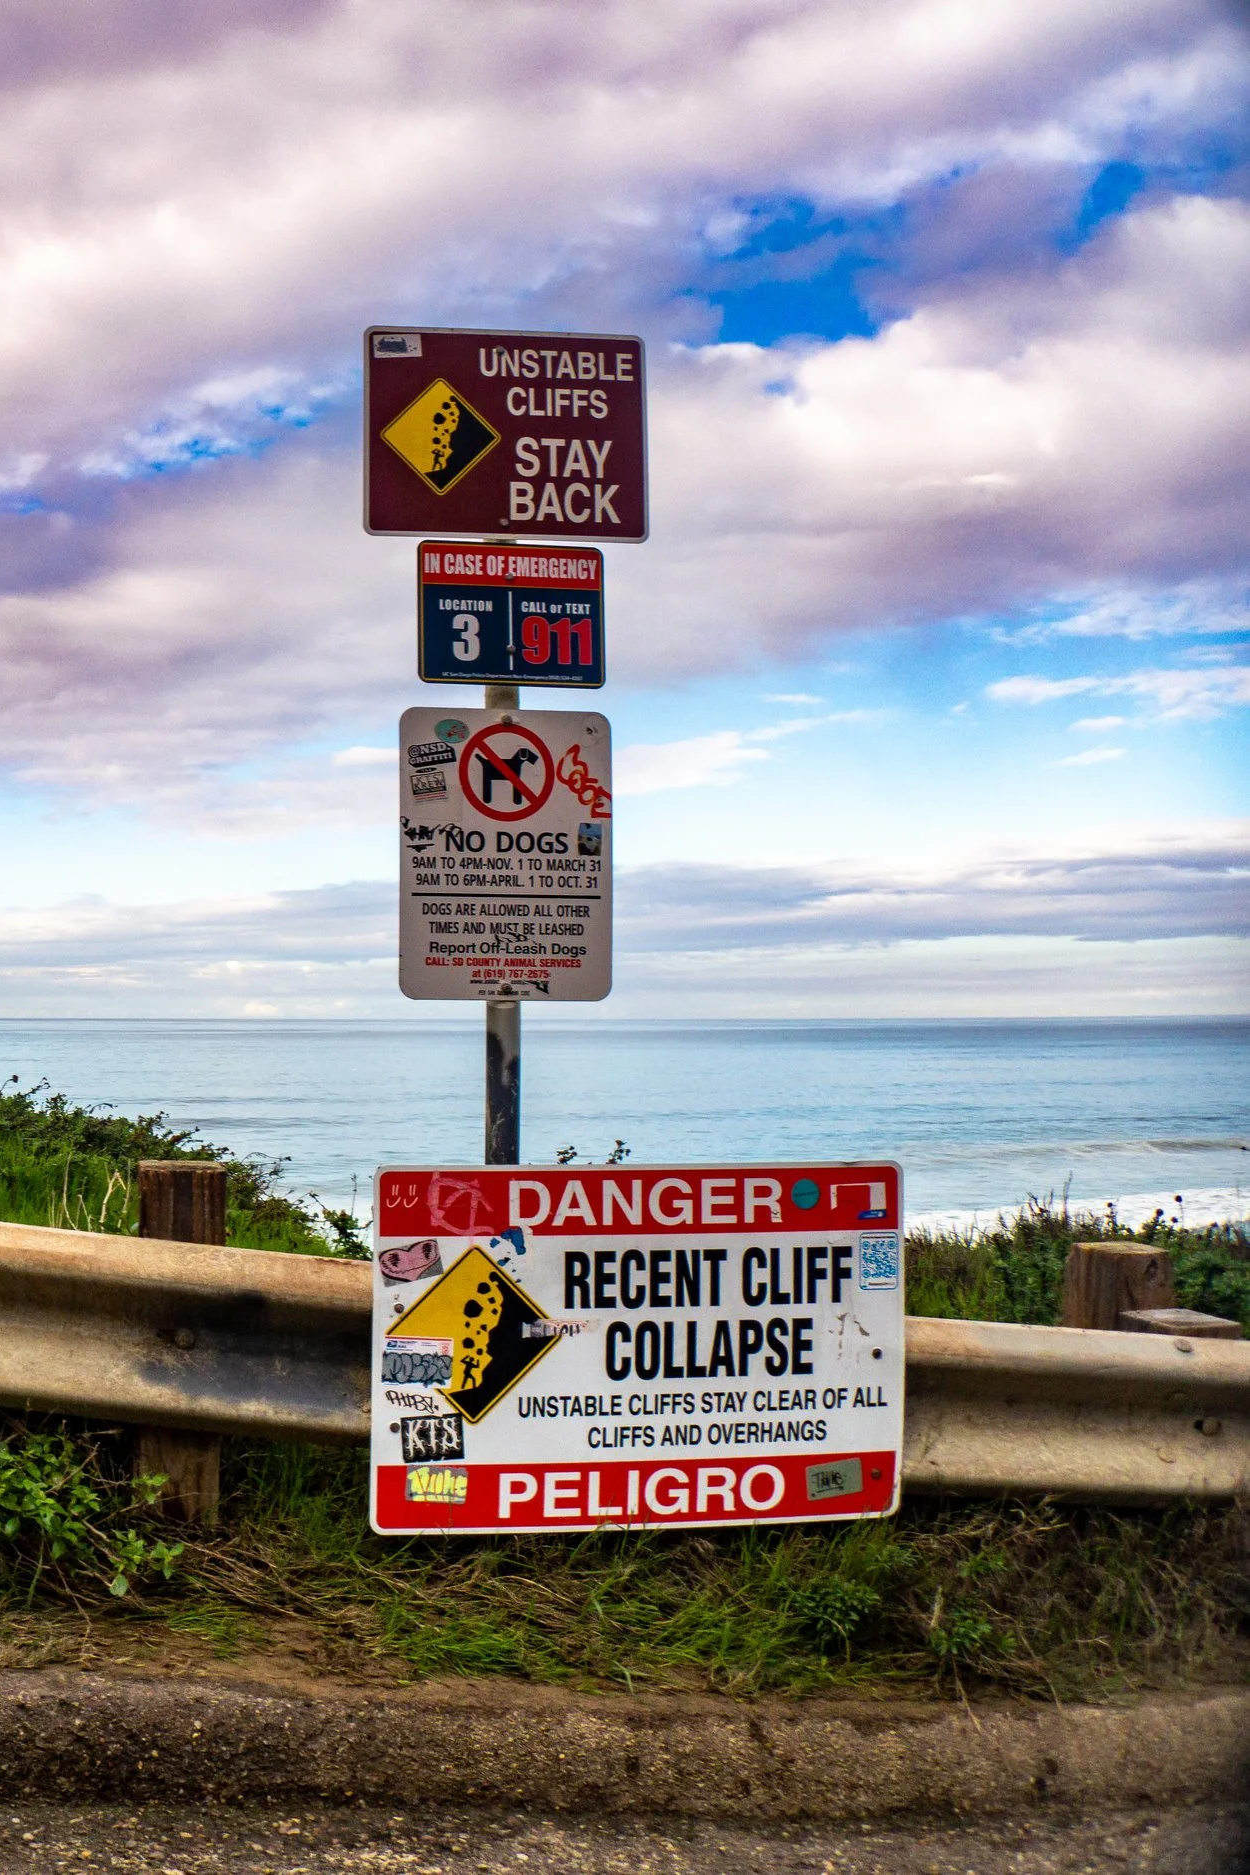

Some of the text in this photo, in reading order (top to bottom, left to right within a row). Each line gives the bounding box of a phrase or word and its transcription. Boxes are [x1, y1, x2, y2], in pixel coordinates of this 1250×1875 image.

[479, 348, 634, 382] UNSTABLE
[506, 387, 608, 419] CLIFFS
[515, 437, 612, 479] STAY
[509, 481, 621, 524] BACK
[424, 553, 597, 580] IN CASE OF EMERGENCY
[439, 599, 493, 612] LOCATION
[521, 601, 591, 615] CALL or TEXT
[452, 613, 480, 662] 3
[521, 615, 592, 665] 911
[409, 752, 453, 765] GRAFFITI
[445, 831, 485, 852] NO
[496, 831, 568, 854] DOGS
[412, 857, 602, 872] 9AM TO 4PM-NOV. 1 TO MARCH 31
[416, 873, 598, 889] 9AM TO 6PM-APRIL. 1 TO OCT. 31
[422, 903, 590, 918] DOGS ARE ALLOWED ALL OTHER
[429, 921, 584, 936] TIMES AND MUST BE LEASHED
[425, 957, 581, 968] CALL: SD COUNTY ANIMAL SERVICES
[429, 941, 587, 958] Report Off-Leash Dogs
[472, 970, 481, 978] at
[483, 969, 506, 980] (619)
[509, 1178, 783, 1227] DANGER
[564, 1246, 853, 1310] RECENT CLIFF
[606, 1317, 813, 1381] COLLAPSE
[518, 1386, 888, 1418] UNSTABLE CLIFFS STAY CLEAR OF ALL
[588, 1420, 827, 1449] CLIFFS AND OVERHANGS
[498, 1464, 785, 1519] PELIGRO
